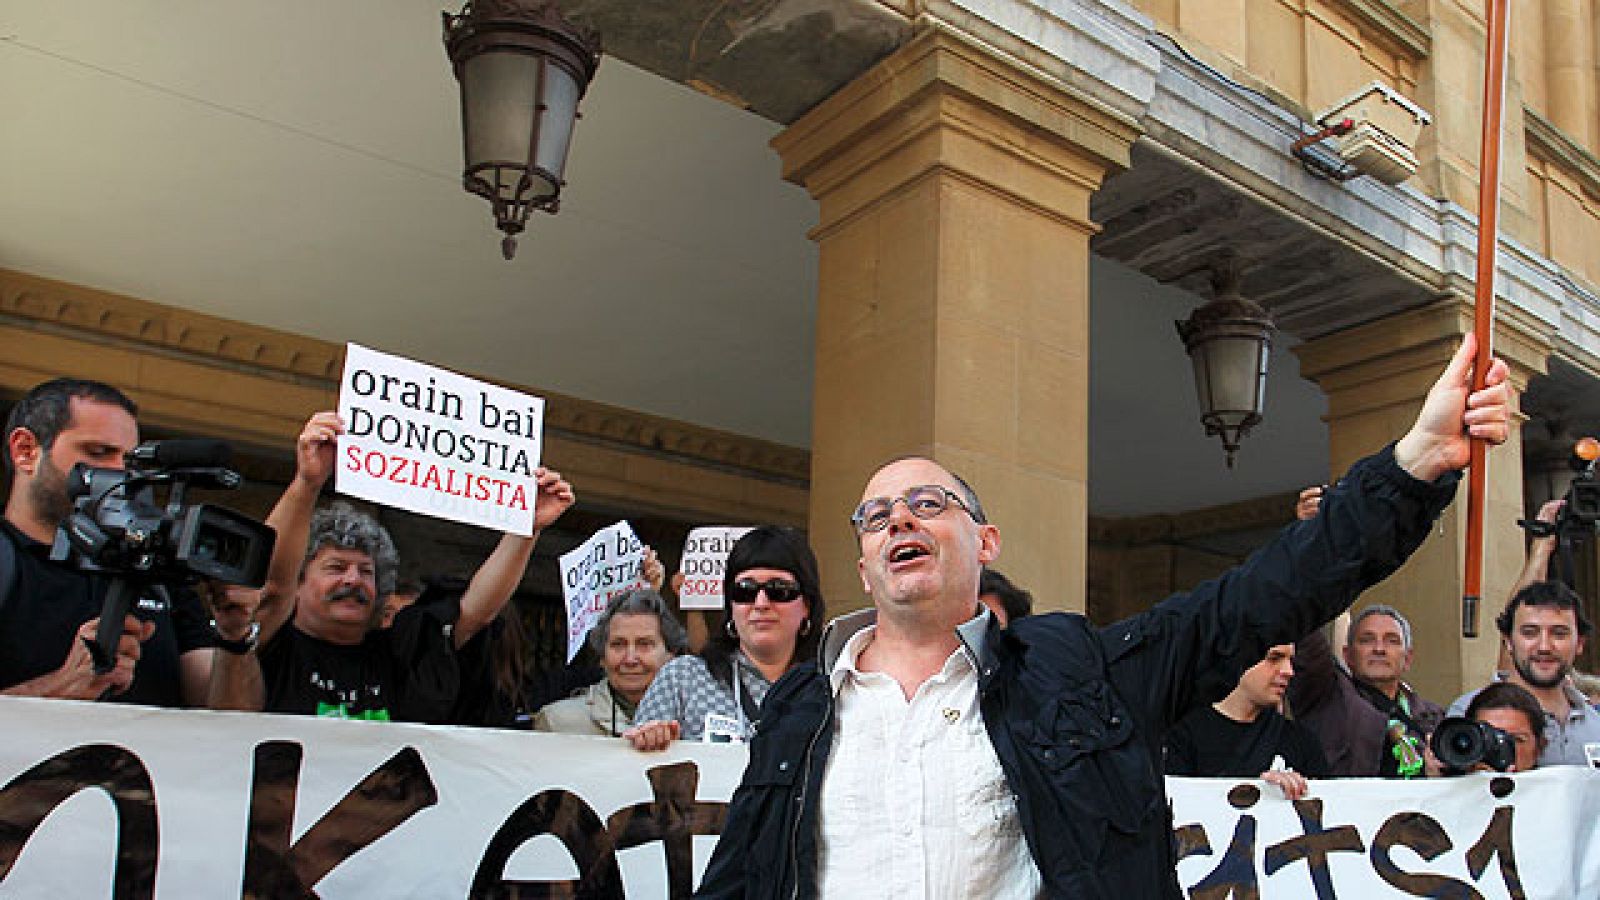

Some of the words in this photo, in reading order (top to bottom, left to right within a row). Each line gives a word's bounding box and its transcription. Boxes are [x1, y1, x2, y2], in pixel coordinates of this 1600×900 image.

[352, 369, 463, 420] orain
[480, 391, 536, 439] bai
[347, 406, 532, 477] DONOSTIA
[346, 444, 528, 511] SOZIALISTA
